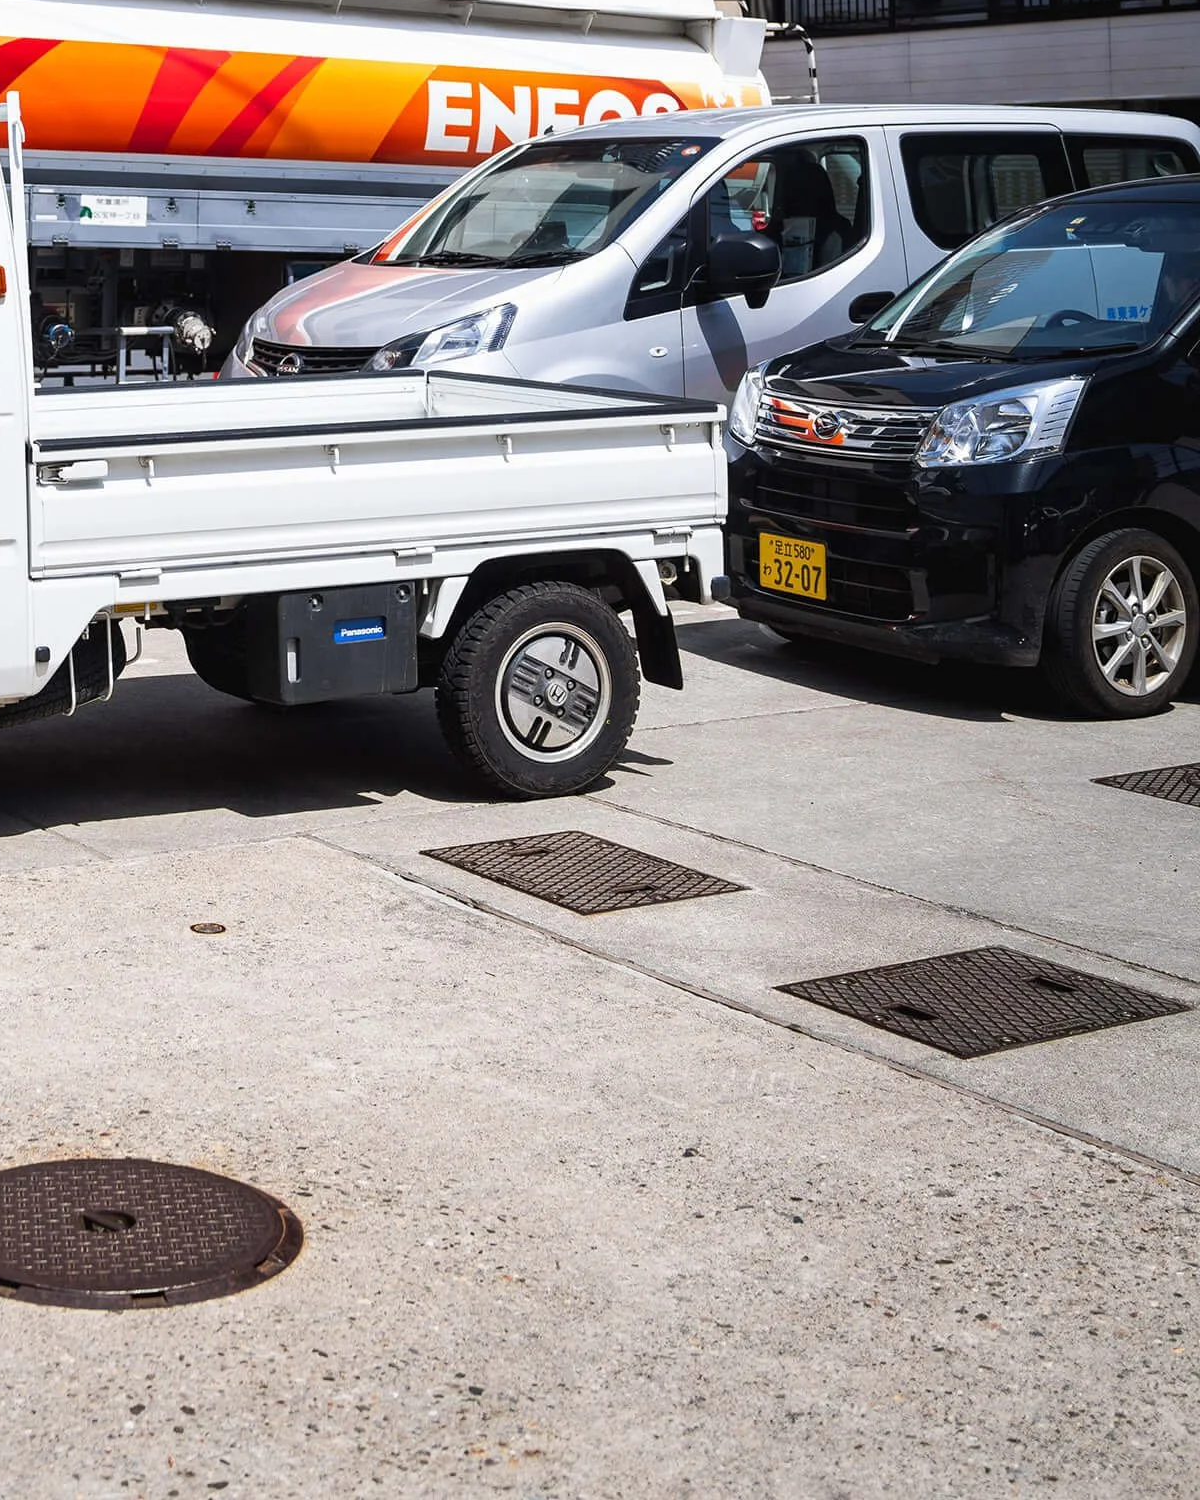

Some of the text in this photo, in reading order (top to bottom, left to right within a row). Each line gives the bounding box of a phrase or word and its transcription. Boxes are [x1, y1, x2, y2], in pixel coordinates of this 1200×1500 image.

[775, 540, 811, 561] 足立 580
[774, 558, 822, 594] 32-07
[340, 624, 383, 638] Panasonic
